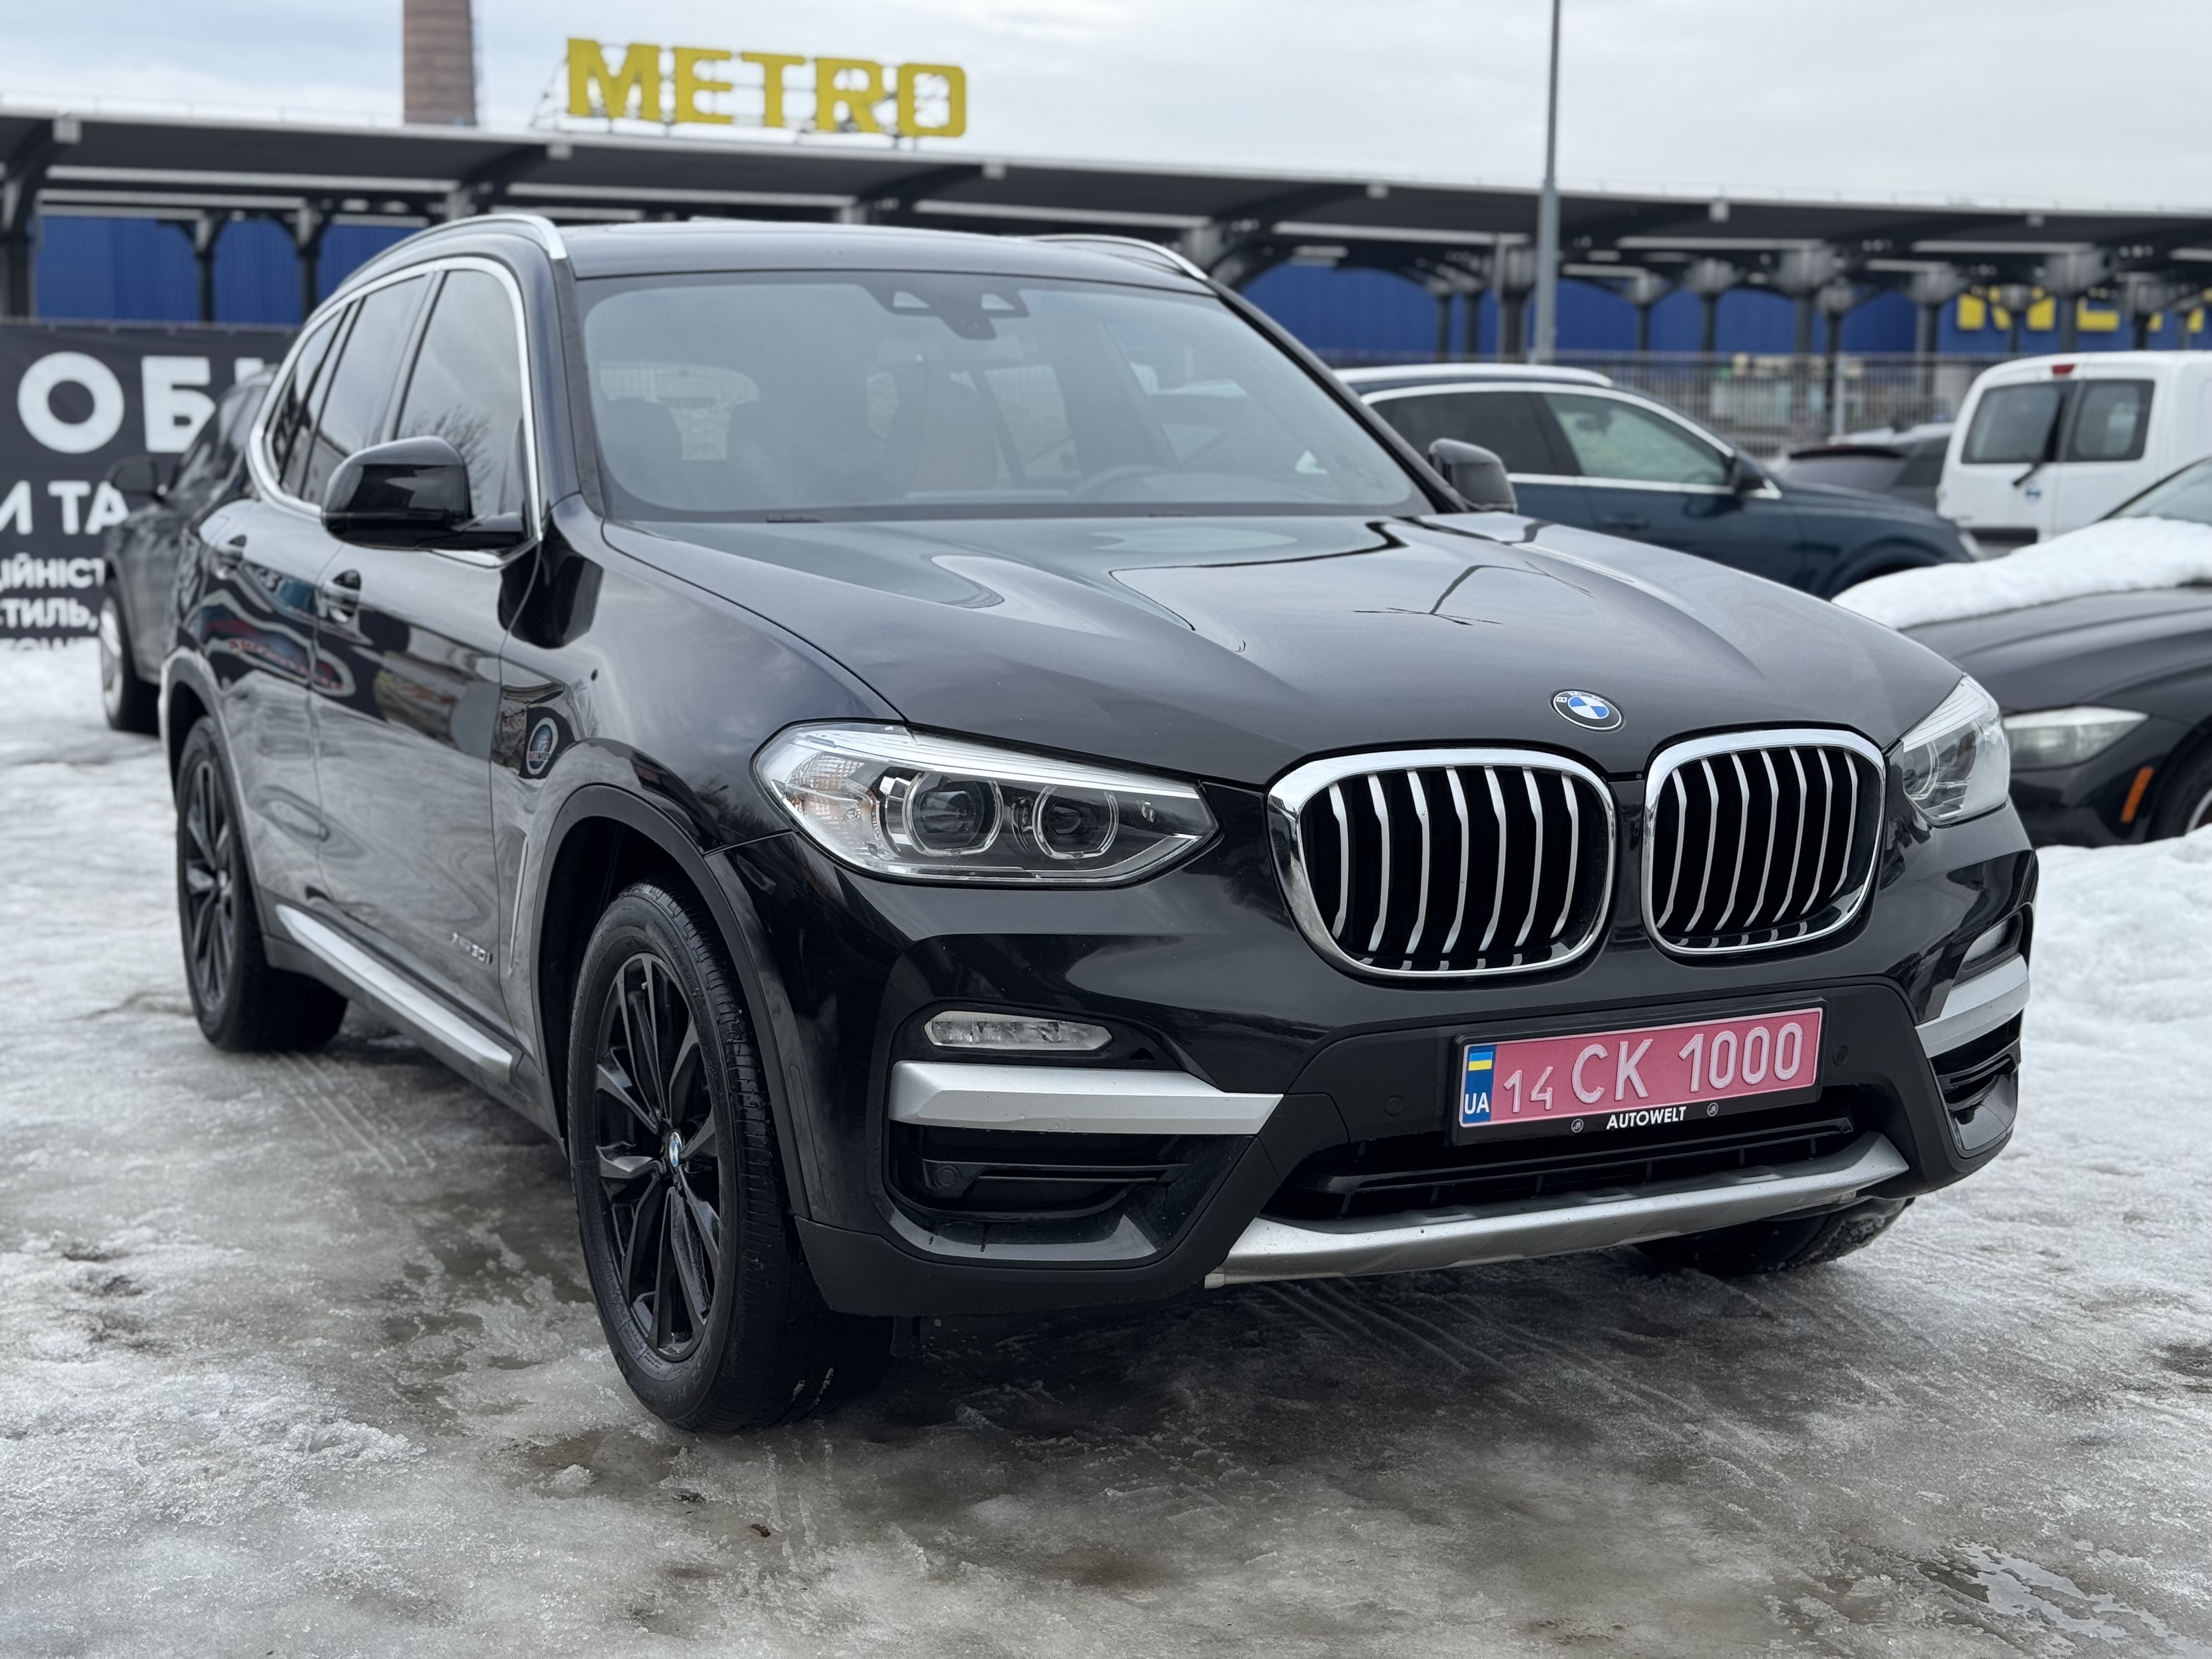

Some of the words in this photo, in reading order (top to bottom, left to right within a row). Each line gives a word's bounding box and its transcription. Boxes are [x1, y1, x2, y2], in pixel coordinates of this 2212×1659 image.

[567, 38, 966, 138] METRO
[18, 351, 266, 454] ОБ
[47, 480, 130, 535] ТА
[0, 552, 105, 592] ІЙНІСТ
[0, 597, 98, 631] ТИЛЬ,
[1503, 1066, 1553, 1113] 14
[1571, 1039, 1654, 1104] CK
[1679, 1023, 1803, 1092] 1000
[1464, 1092, 1489, 1114] UA
[1605, 1106, 1686, 1130] AUTOWELT
